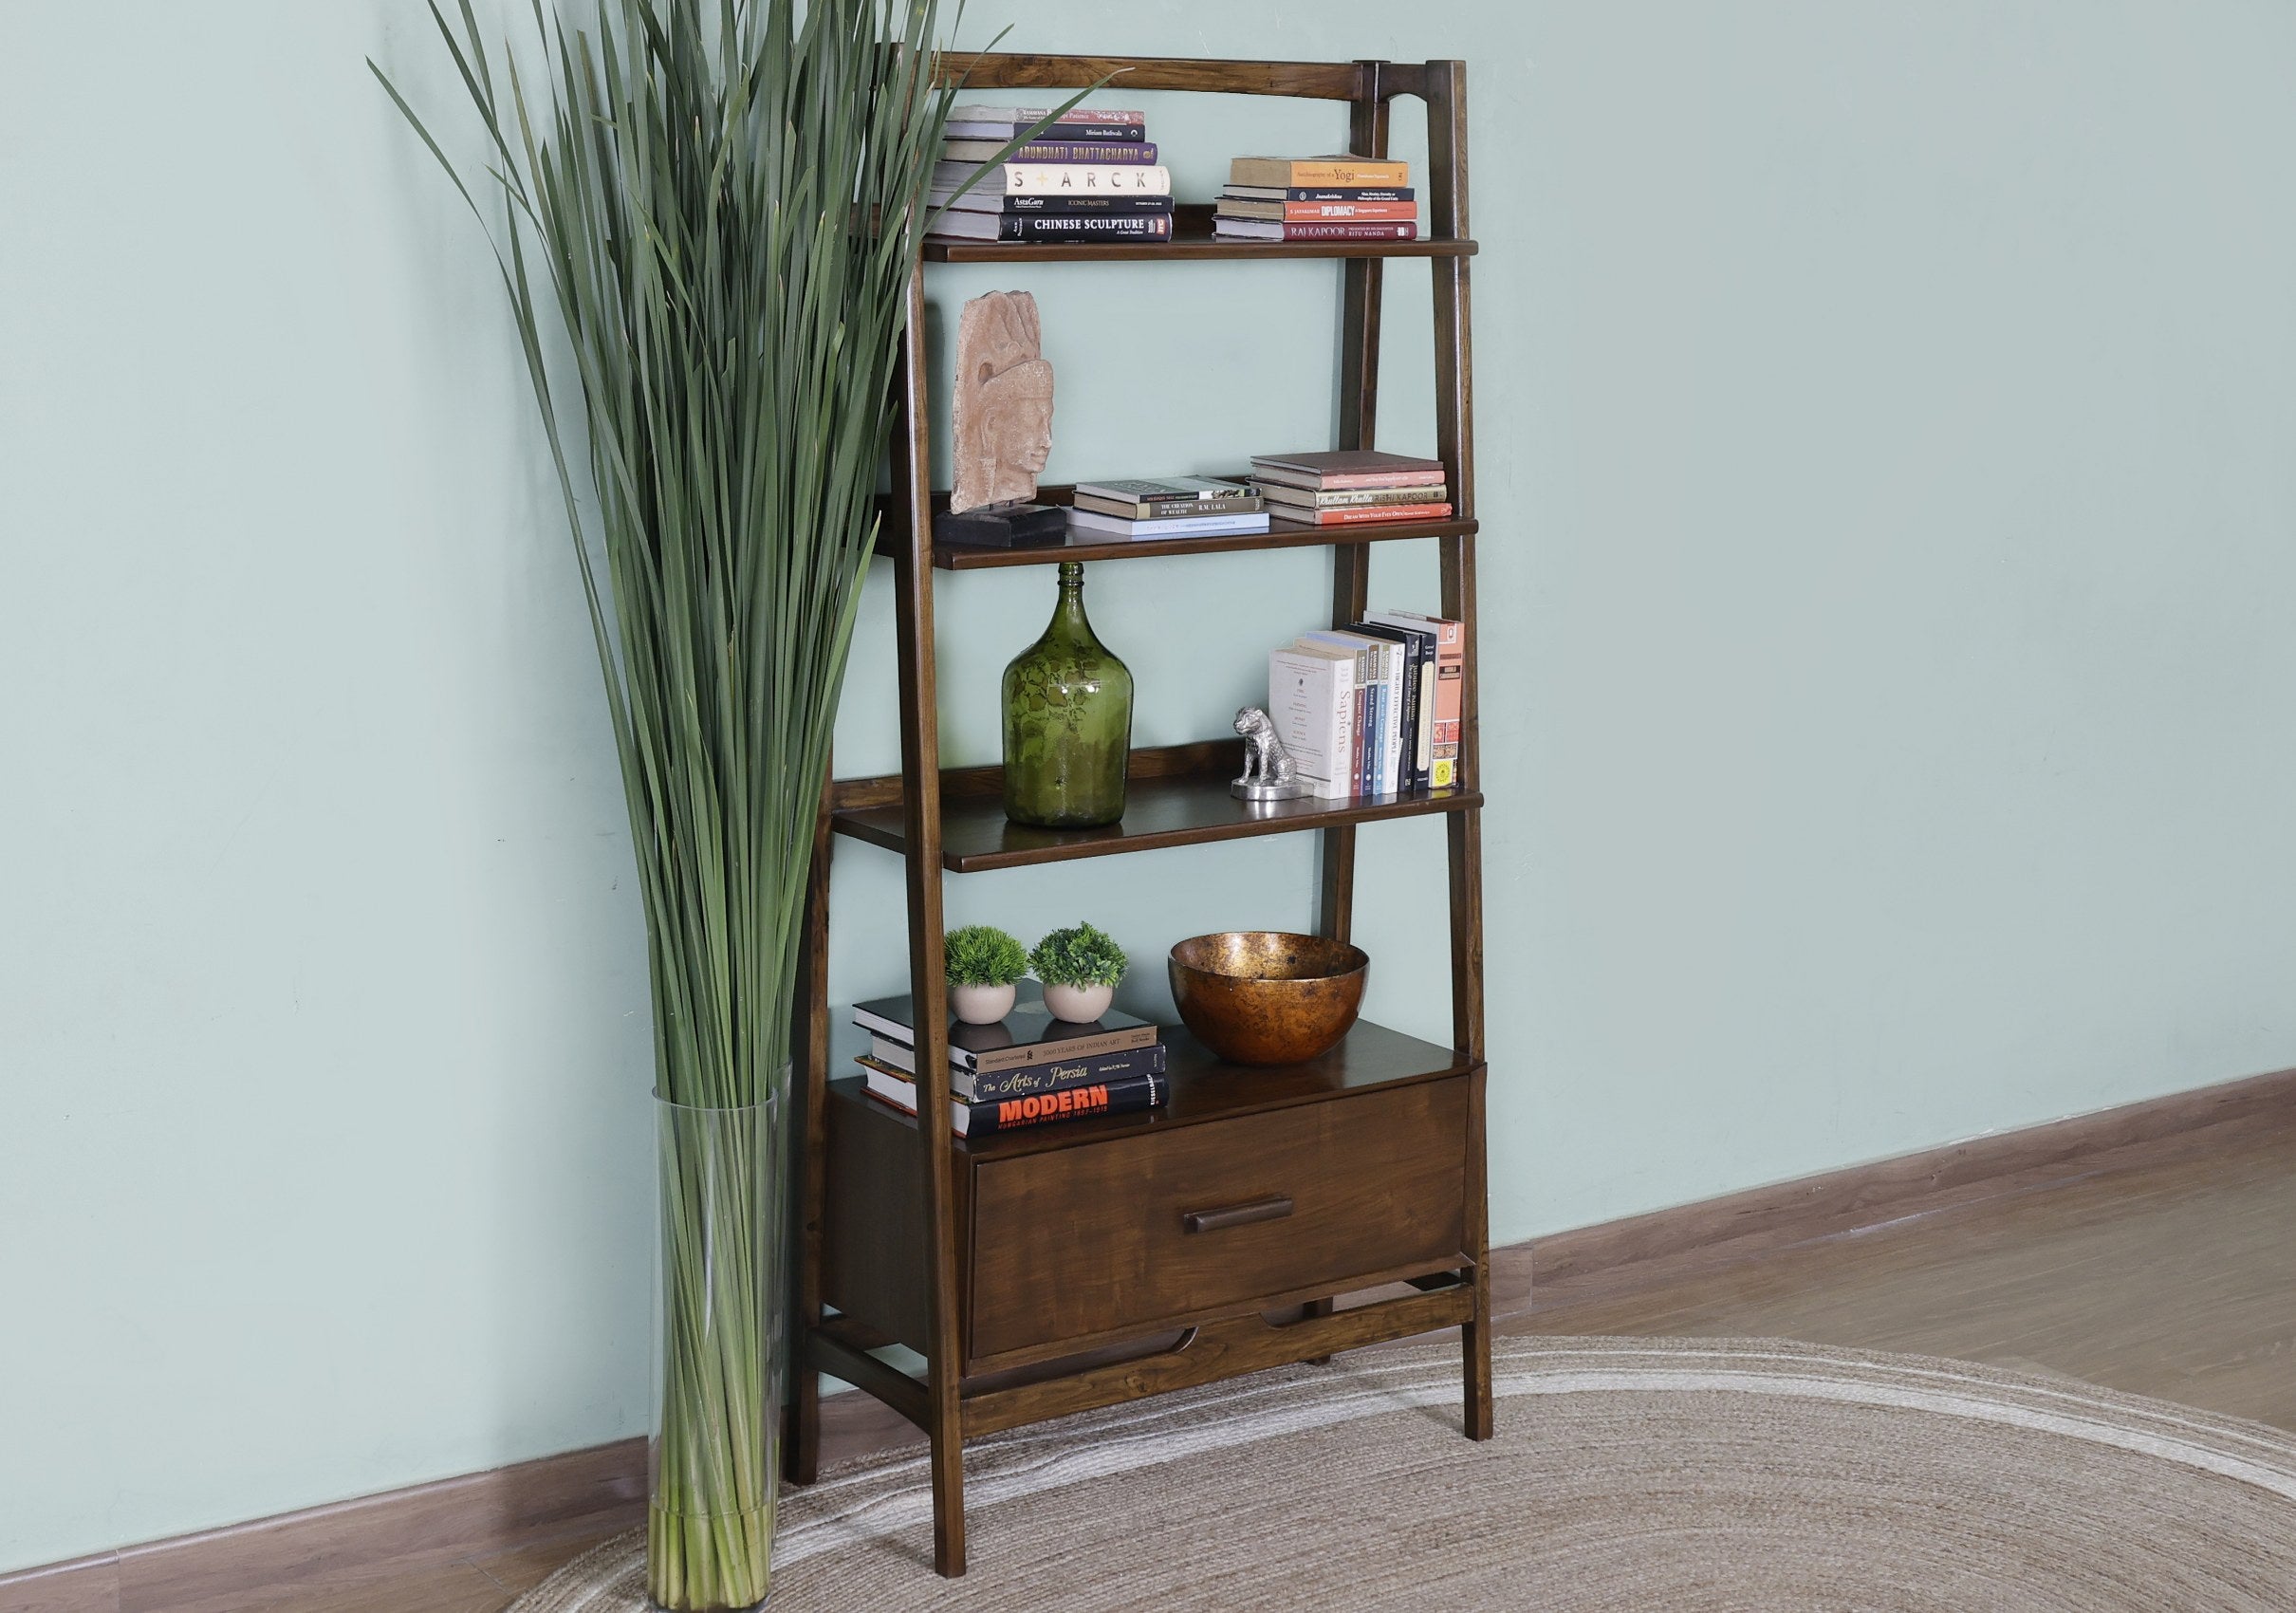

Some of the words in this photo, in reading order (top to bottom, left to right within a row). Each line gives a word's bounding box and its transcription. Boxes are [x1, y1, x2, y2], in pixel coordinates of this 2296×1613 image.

[1018, 146, 1068, 159] ARUNDHATI
[1072, 146, 1139, 160] BHATTACHARYA
[1334, 168, 1355, 182] Yogi
[1013, 197, 1045, 206] AstaGuru
[1321, 205, 1356, 216] DIPLOMACY
[1034, 219, 1082, 230] CHINESE
[1083, 218, 1144, 230] SCULPTURE
[1290, 227, 1306, 236] RAJ
[1308, 227, 1345, 236] KAPOOR
[1320, 496, 1349, 505] Khullam
[1349, 493, 1373, 503] Khulla
[1375, 493, 1394, 502] RISHI
[1396, 491, 1428, 501] KAPOOR
[1336, 691, 1351, 754] Sapiens
[1057, 1046, 1076, 1054] YEARS
[1086, 1041, 1108, 1049] INDIAN
[985, 1056, 1004, 1065] Standard
[983, 1084, 996, 1093] The
[999, 1072, 1032, 1093] Arts
[1033, 1077, 1041, 1088] of
[1045, 1065, 1088, 1088] Persia
[998, 1084, 1108, 1123] MODERN
[1039, 1112, 1070, 1122] PAINTING
